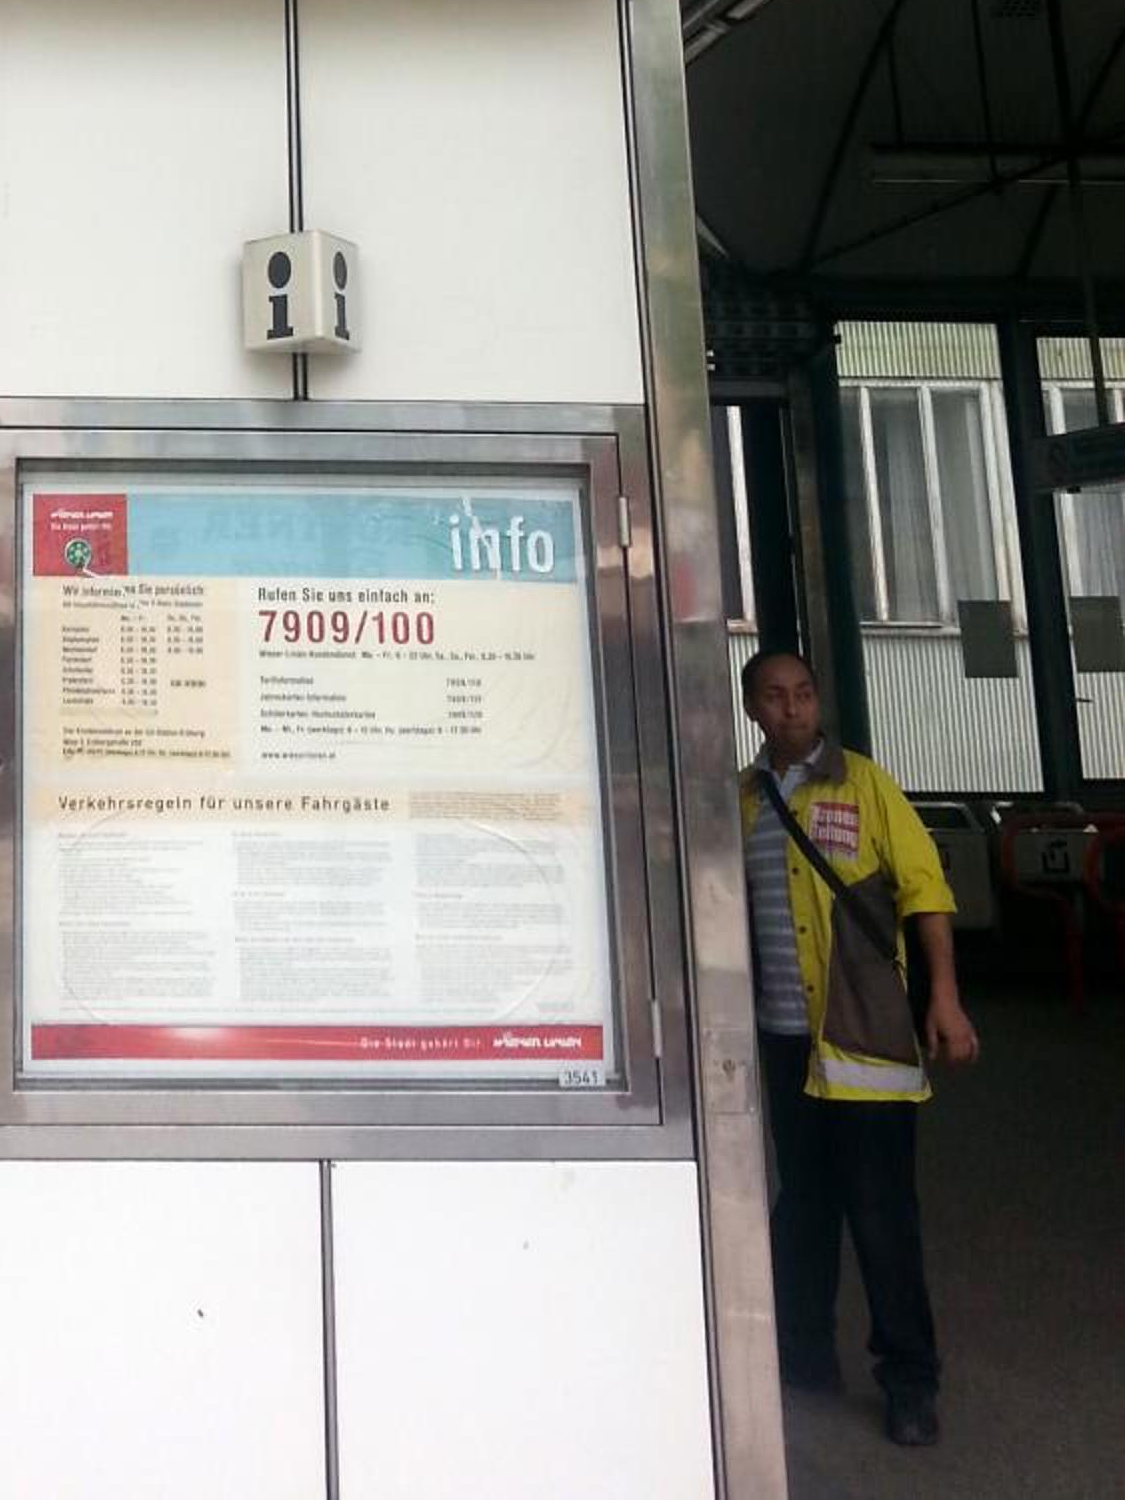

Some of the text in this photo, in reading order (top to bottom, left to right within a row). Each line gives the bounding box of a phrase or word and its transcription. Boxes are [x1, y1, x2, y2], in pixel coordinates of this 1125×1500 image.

[448, 512, 555, 574] info
[258, 587, 296, 602] Rufen
[302, 587, 324, 602] Sie
[328, 590, 352, 602] uns
[358, 588, 408, 603] einfach
[258, 610, 435, 645] 7909/100
[58, 795, 192, 813] Verkehrsregeln
[200, 795, 225, 810] für
[233, 798, 292, 811] unsere
[301, 795, 390, 814] Fahrgäste
[564, 1070, 598, 1085] 3541
